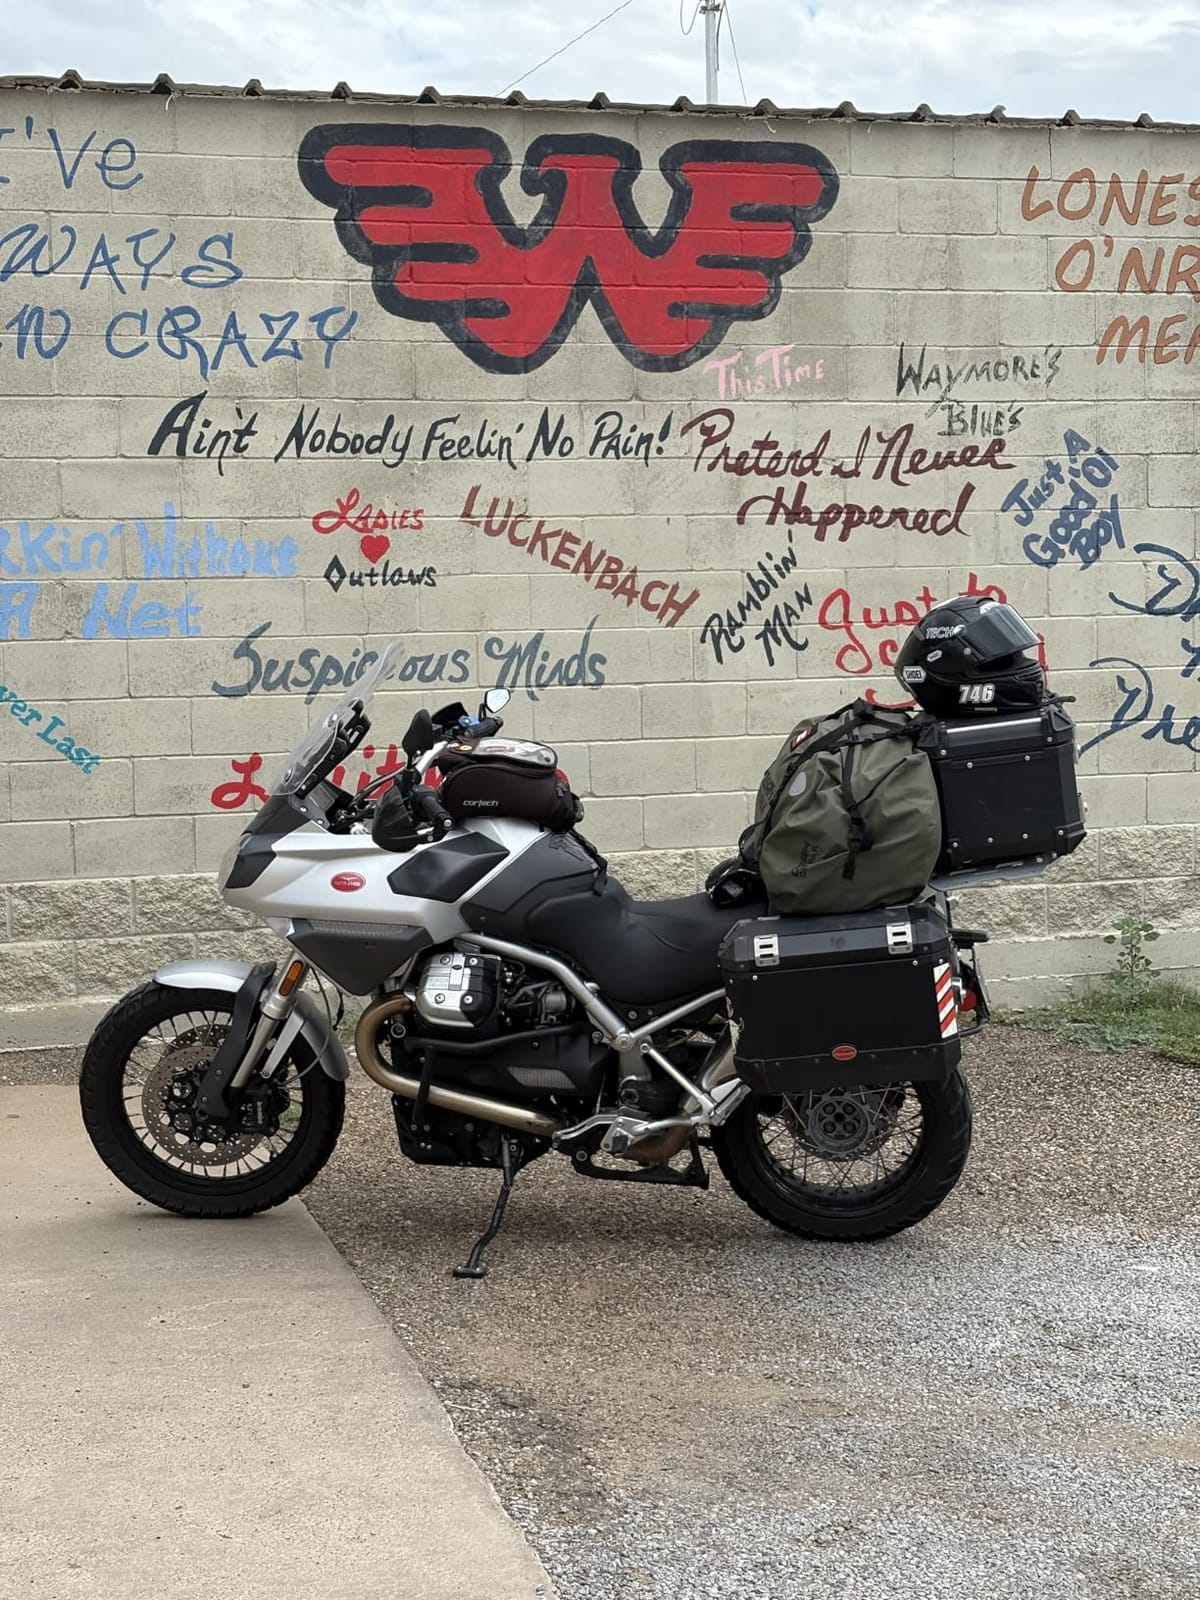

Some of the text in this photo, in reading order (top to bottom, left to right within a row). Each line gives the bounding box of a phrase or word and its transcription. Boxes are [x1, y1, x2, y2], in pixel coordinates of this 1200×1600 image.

[105, 304, 359, 383] CRAZY
[147, 389, 258, 476] Ain't
[273, 403, 414, 469] Nobody
[422, 413, 525, 471] Feelin'
[526, 406, 574, 463] No
[680, 407, 831, 478] Pretend
[736, 481, 976, 542] Happened
[1000, 458, 1065, 527] Just
[1022, 479, 1098, 568] Good
[323, 554, 437, 592] Outlaws
[459, 483, 701, 628] LUCKENBACH
[81, 583, 204, 639] Net
[755, 582, 813, 667] MAN
[818, 588, 937, 674] Just
[211, 614, 607, 705] Suspicous Minds
[958, 682, 995, 704] 746
[36, 715, 100, 774] Last
